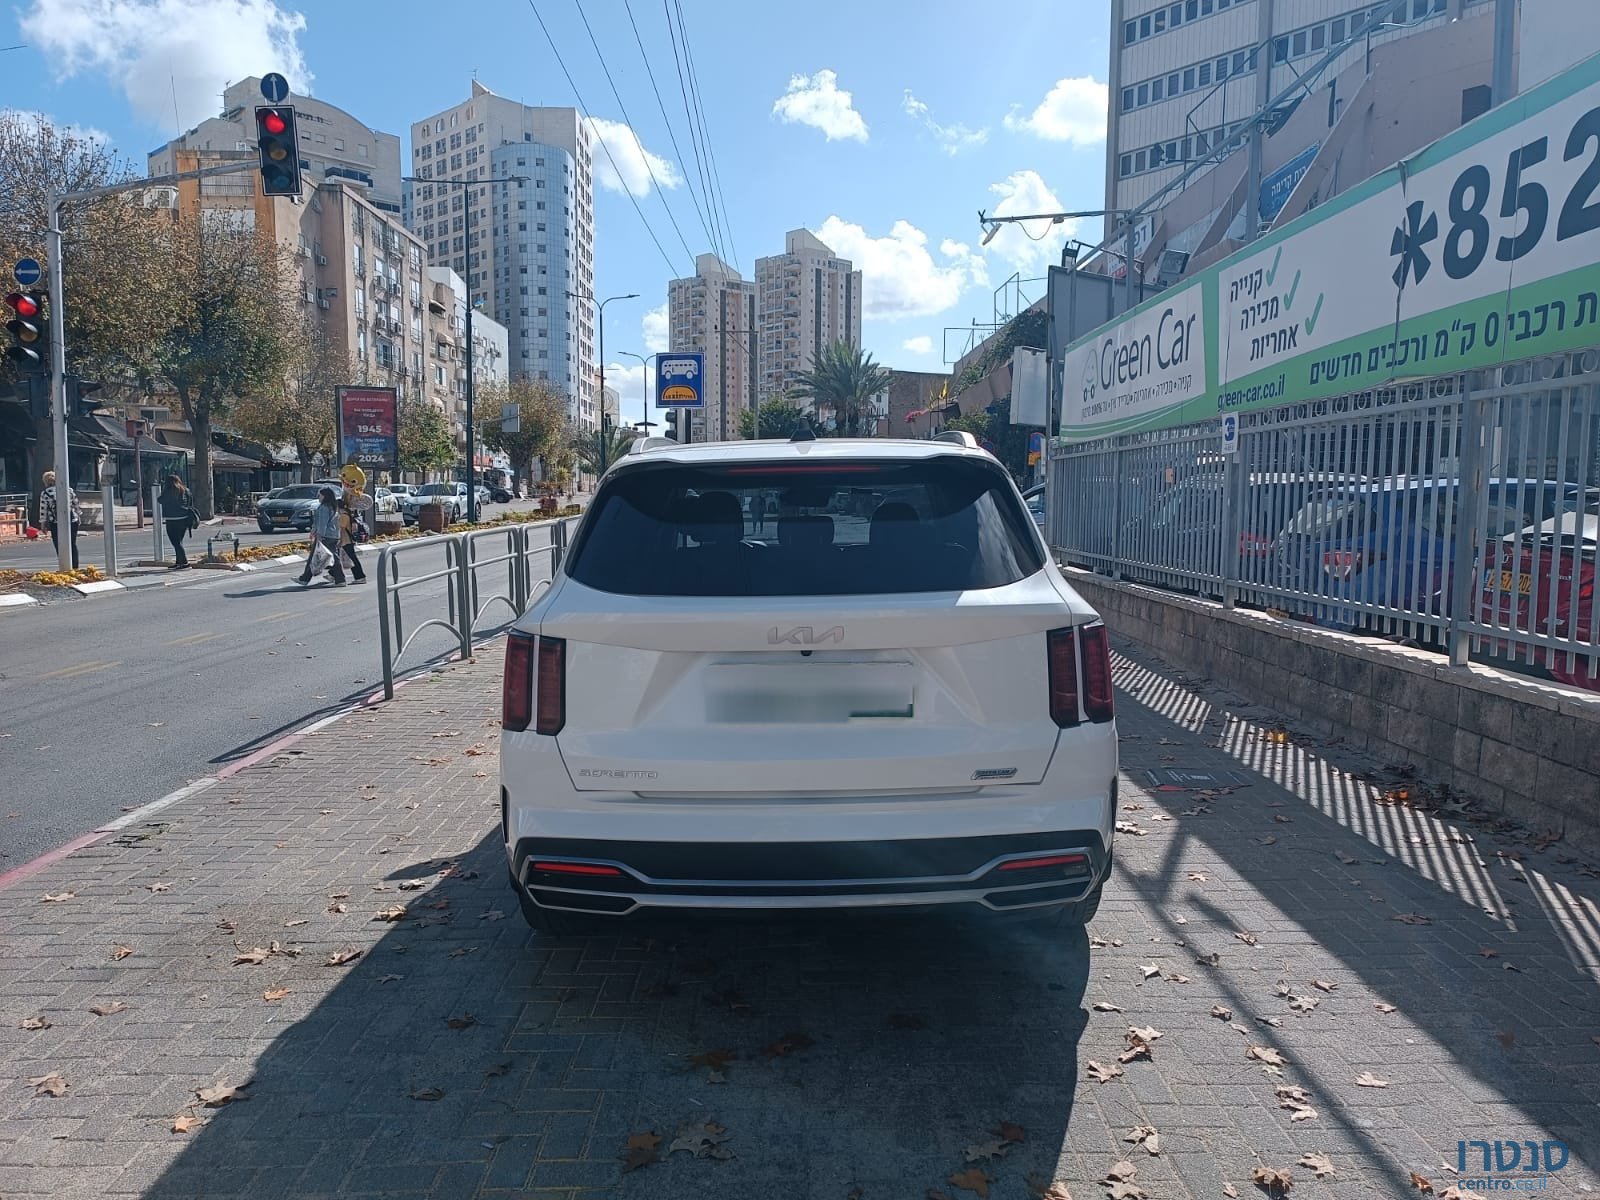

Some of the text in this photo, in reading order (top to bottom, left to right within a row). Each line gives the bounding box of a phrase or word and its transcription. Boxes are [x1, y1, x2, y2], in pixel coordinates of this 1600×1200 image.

[1271, 174, 1292, 197] קדימה
[1230, 268, 1263, 303] קנייה
[1240, 295, 1280, 331] מכירה
[1484, 311, 1500, 348] 0
[1507, 300, 1566, 342] רכבי
[1100, 308, 1196, 390] Green Car
[1249, 323, 1299, 361] אחריות
[1367, 334, 1428, 373] ורכבים
[1177, 374, 1192, 393] קניה
[1309, 351, 1362, 386] חדשים
[1155, 380, 1173, 399] מכירה
[1217, 373, 1286, 412] green-car.co.il
[357, 425, 382, 433] 1945
[358, 455, 385, 463] 2024
[767, 626, 845, 645] KIA
[579, 768, 659, 779] SORENTO
